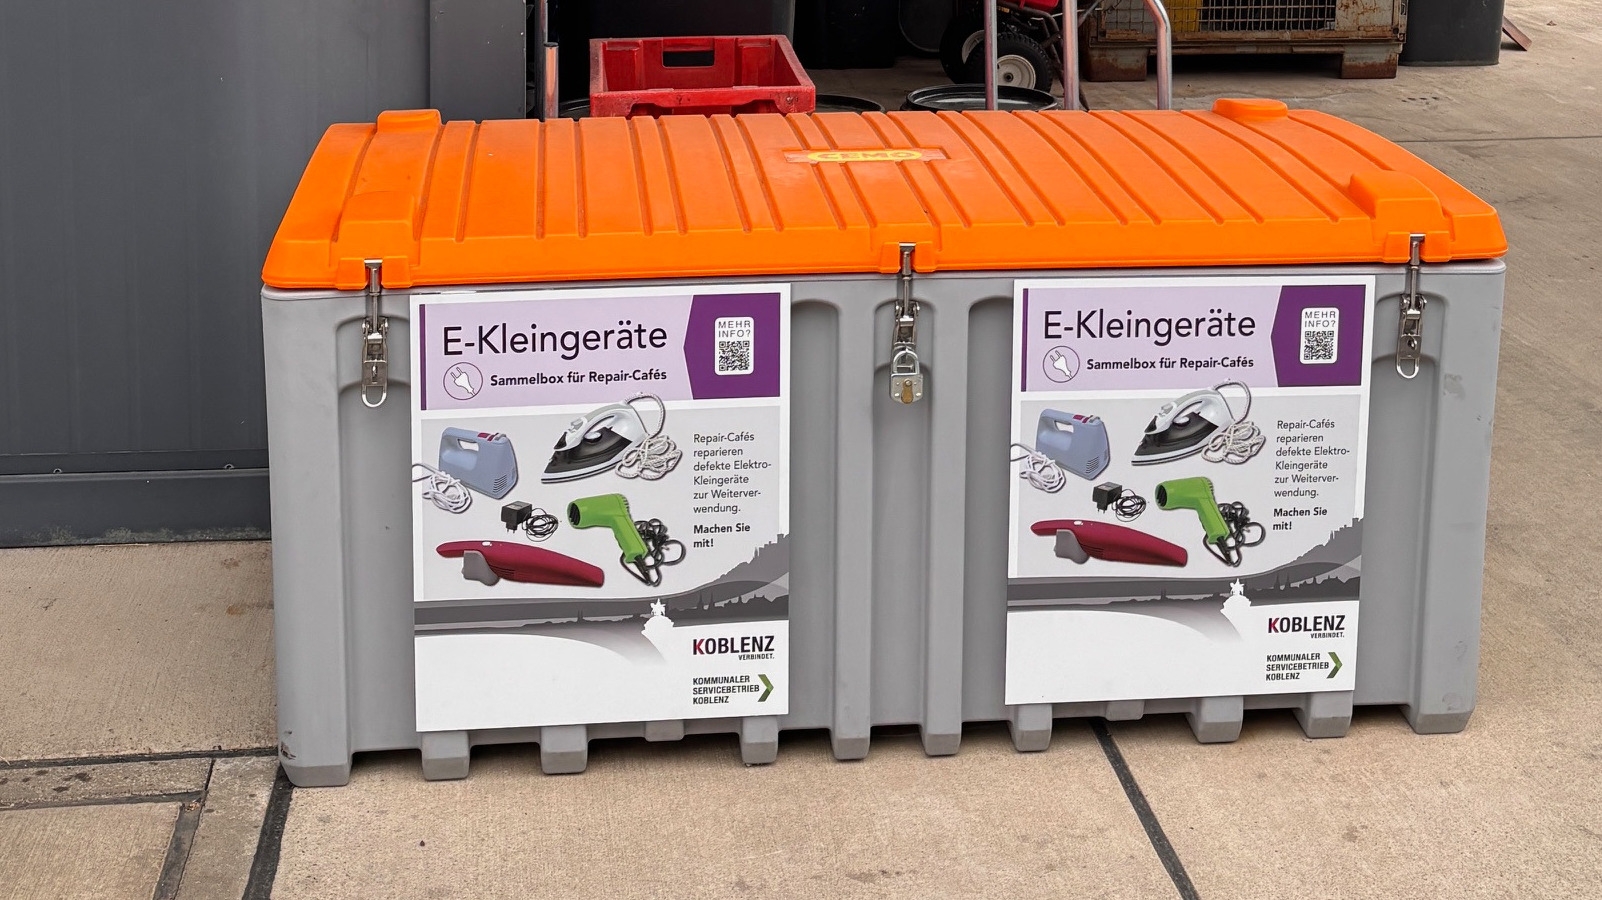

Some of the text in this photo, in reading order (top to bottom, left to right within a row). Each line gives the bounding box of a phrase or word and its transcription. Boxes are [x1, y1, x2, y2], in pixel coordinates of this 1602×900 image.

[818, 152, 912, 160] CEMO
[1305, 311, 1336, 319] MEHR
[718, 320, 751, 328] MEHR
[1044, 308, 1256, 347] E-Kleingeräte
[1305, 320, 1336, 328] INFO?
[718, 329, 751, 338] INFO?
[443, 320, 668, 360] E-Kleingeräte
[1086, 355, 1254, 371] Sammelbox für Repair-Cafés
[490, 368, 667, 387] Sammelbox für Repair-Cafés
[1277, 419, 1335, 431] Repair-Cafés
[693, 431, 755, 445] Repair-Cafés
[1276, 434, 1324, 446] reparieren
[693, 447, 743, 459] reparieren
[1276, 446, 1350, 456] defekte Elektro-
[693, 460, 771, 471] defekte Elektro-
[1275, 460, 1328, 472] Kleingeräte
[693, 474, 749, 487] Kleingeräte
[1274, 474, 1339, 484] zur Weiterver-
[693, 489, 761, 500] zur Weiterver-
[1274, 488, 1319, 498] wendung.
[693, 503, 741, 514] wendung.
[1273, 507, 1327, 517] Machen Sie
[693, 523, 751, 534] Machen Sie
[1273, 522, 1292, 530] mit!
[693, 539, 714, 548] mit!
[1268, 615, 1346, 633] KOBLENZ
[693, 635, 774, 655] KOBLENZ
[1266, 653, 1320, 662] KOMMUNALER
[1266, 662, 1329, 671] SERVICEBETRIEB
[692, 675, 750, 685] KOMMUNALER
[1265, 673, 1300, 681] KOBLENZ
[692, 685, 760, 695] SERVICEBETRIEB
[692, 696, 729, 704] KOBLENZ
